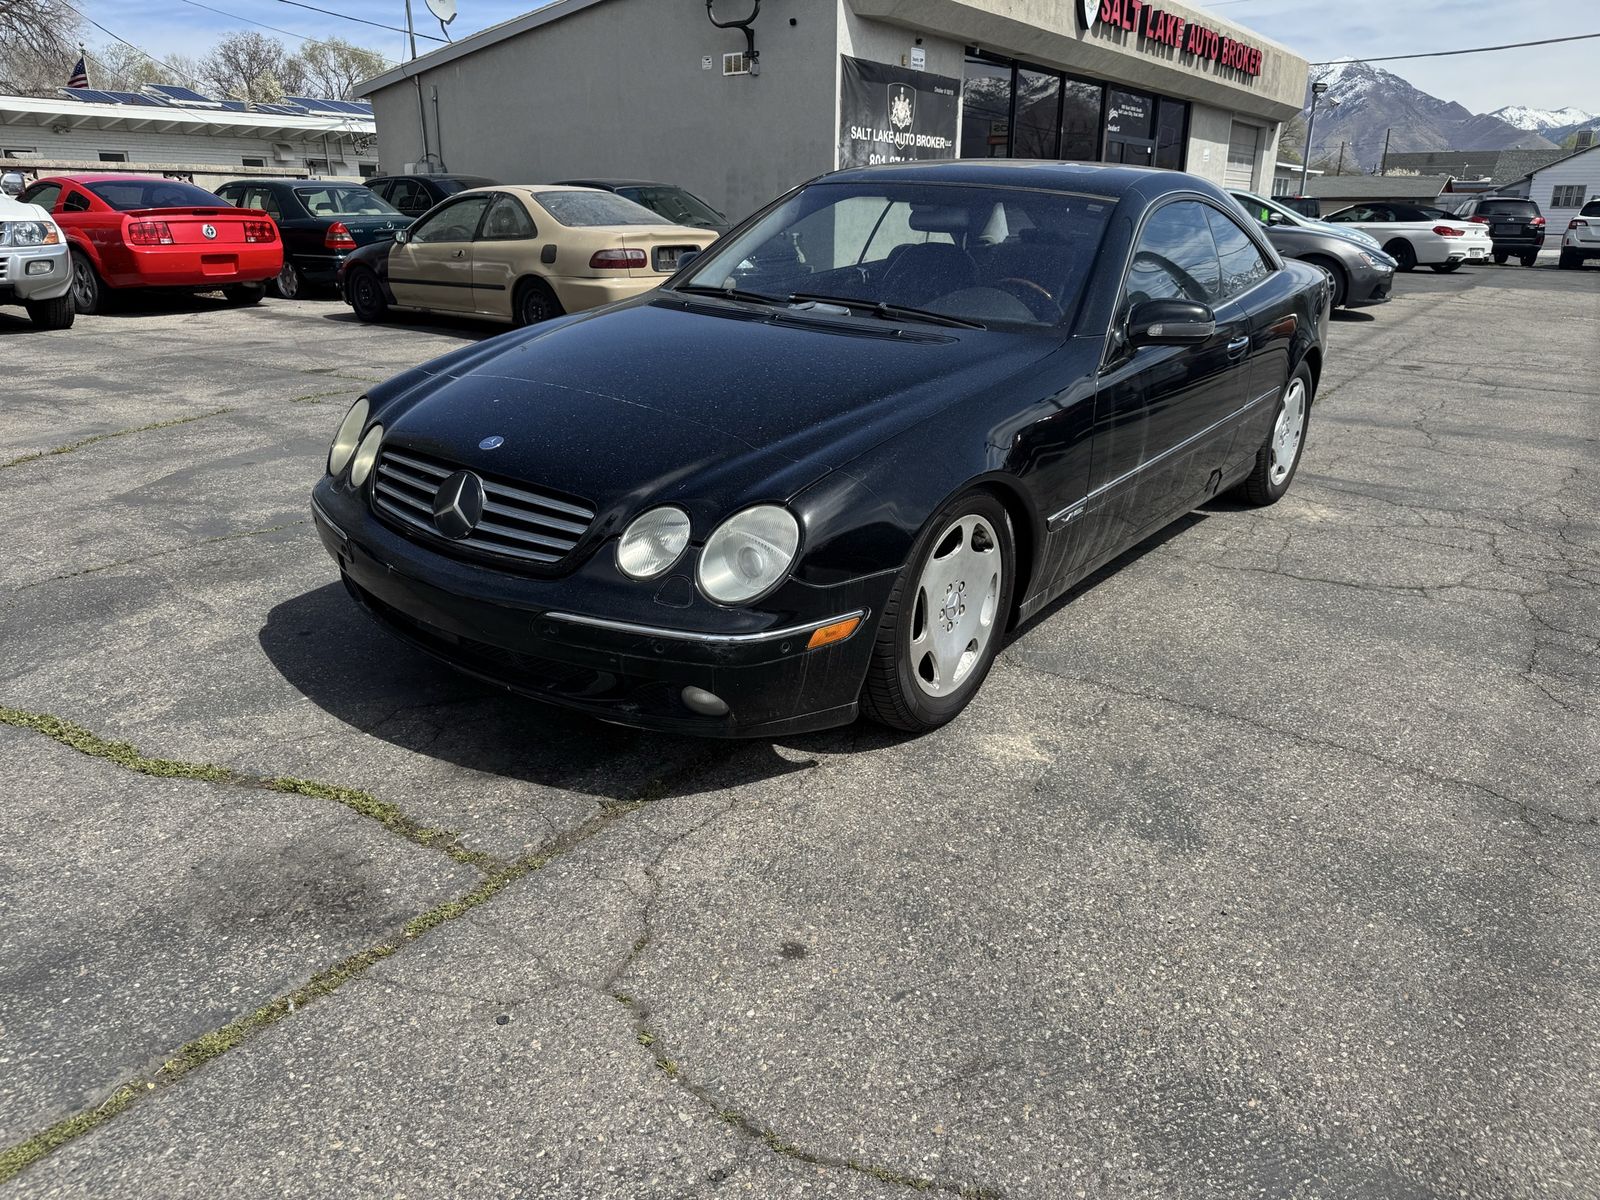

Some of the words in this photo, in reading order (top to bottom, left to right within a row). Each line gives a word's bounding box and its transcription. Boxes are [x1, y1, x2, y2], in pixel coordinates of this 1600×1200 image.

[1101, 0, 1142, 33] SALT
[1146, 5, 1185, 49] LAKE
[1187, 24, 1219, 60] AUTO
[1221, 36, 1262, 77] BROKER
[851, 126, 872, 141] SALT
[873, 128, 894, 144] LAKE
[895, 132, 915, 146] AUTO
[916, 134, 945, 149] BROKER
